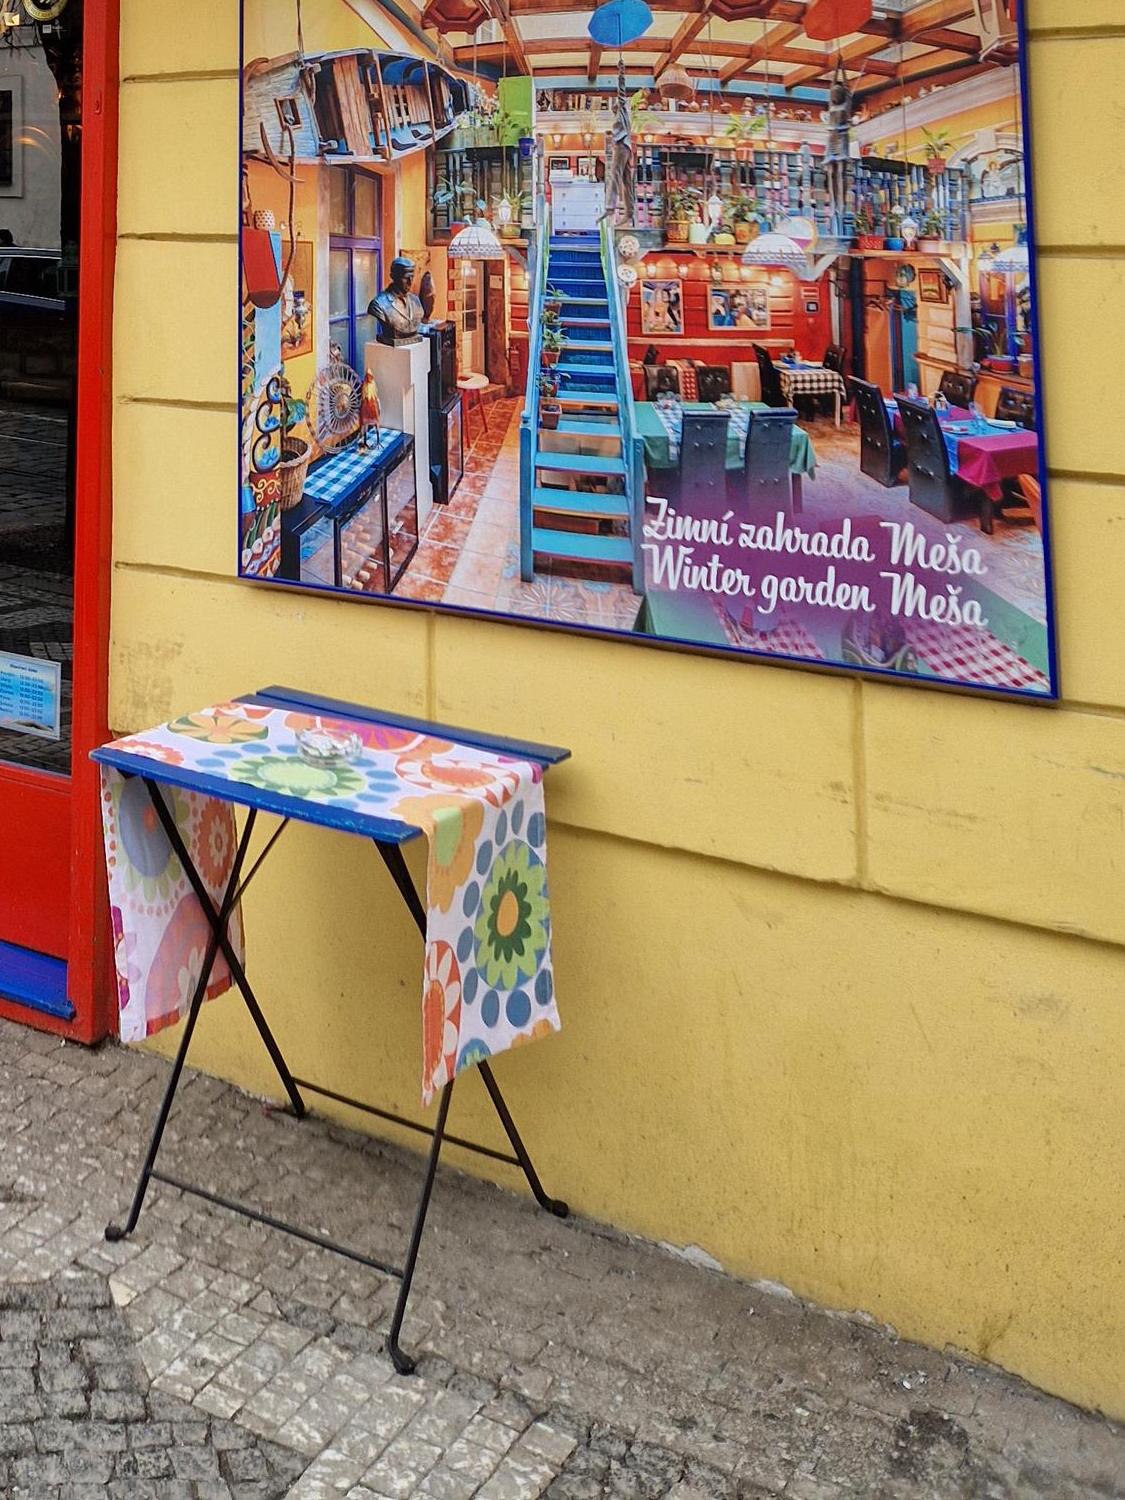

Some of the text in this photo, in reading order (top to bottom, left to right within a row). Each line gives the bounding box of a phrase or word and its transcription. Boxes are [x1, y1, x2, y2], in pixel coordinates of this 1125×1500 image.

[641, 494, 989, 576] Zimní zahrada Meša
[641, 542, 990, 628] Winter garden Meša
